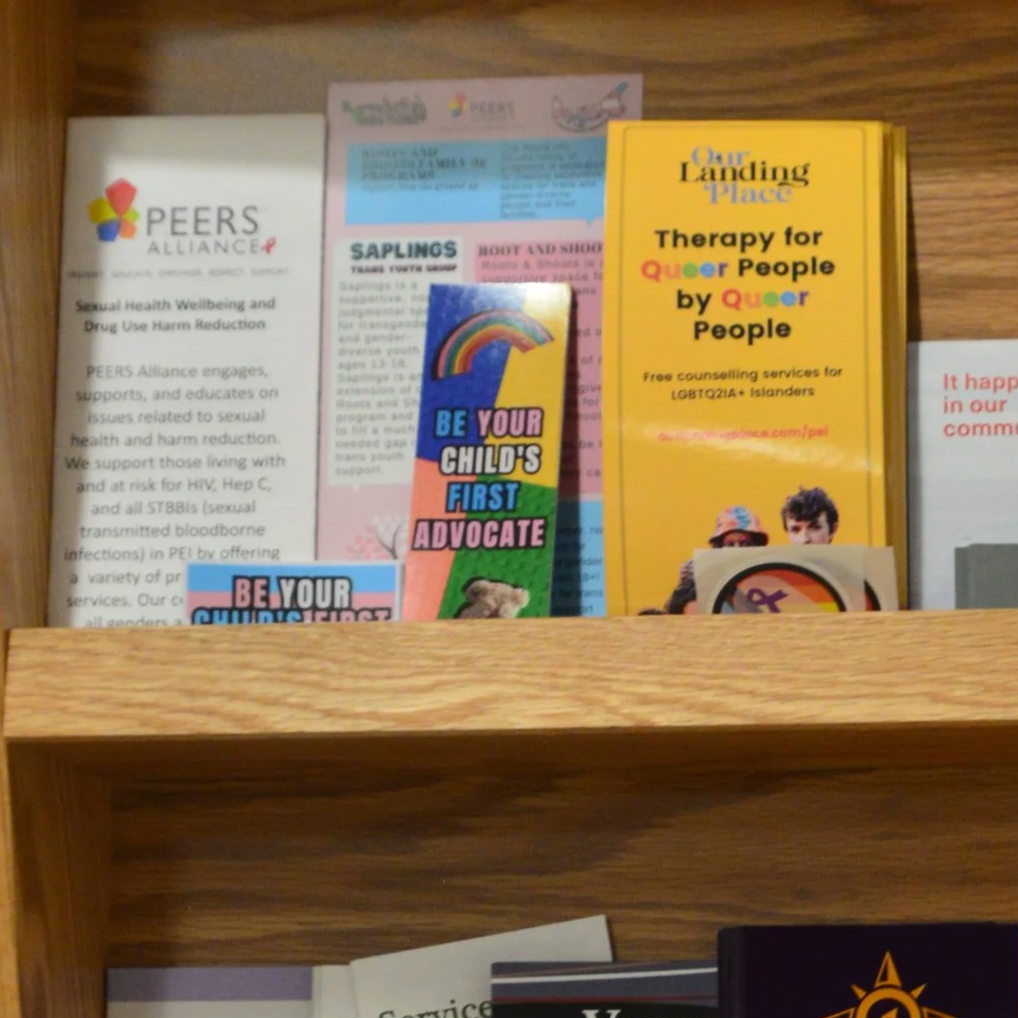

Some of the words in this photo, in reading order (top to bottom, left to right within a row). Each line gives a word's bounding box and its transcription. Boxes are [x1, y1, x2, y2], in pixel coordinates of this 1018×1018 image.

[691, 146, 749, 166] Our
[679, 161, 810, 186] Landing
[703, 182, 793, 204] Place
[146, 205, 259, 236] PEERS
[147, 238, 259, 255] ALLIANCE
[350, 241, 457, 260] SAPLINGS
[655, 230, 774, 253] Therapy
[785, 227, 822, 246] for
[641, 260, 728, 282] Queer
[739, 257, 835, 282] People
[75, 300, 120, 312] Sexual
[125, 300, 171, 312] Health
[175, 298, 245, 313] Wellbeing
[249, 298, 275, 310] and
[677, 290, 711, 315] by
[722, 287, 809, 311] Queer
[84, 319, 117, 334] Drug
[122, 320, 147, 332] Use
[152, 319, 191, 331] Harm
[195, 318, 266, 330] Reduction
[694, 319, 791, 345] People
[86, 365, 133, 378] PEERS
[137, 365, 197, 378] Alliance
[202, 365, 268, 379] engages,
[643, 372, 672, 382] Free
[677, 369, 758, 382] counselling
[763, 367, 819, 379] services
[824, 366, 842, 377] for
[943, 373, 958, 390] It
[751, 386, 815, 398] Islanders
[943, 396, 962, 413] in
[969, 399, 1006, 413] our
[434, 409, 468, 437] BE
[477, 407, 543, 437] YOUR
[439, 444, 542, 475] CHILD'S
[445, 481, 521, 513] FIRST
[412, 517, 548, 550] ADVOCATE
[235, 578, 268, 608] BE
[280, 578, 351, 608] YOUR
